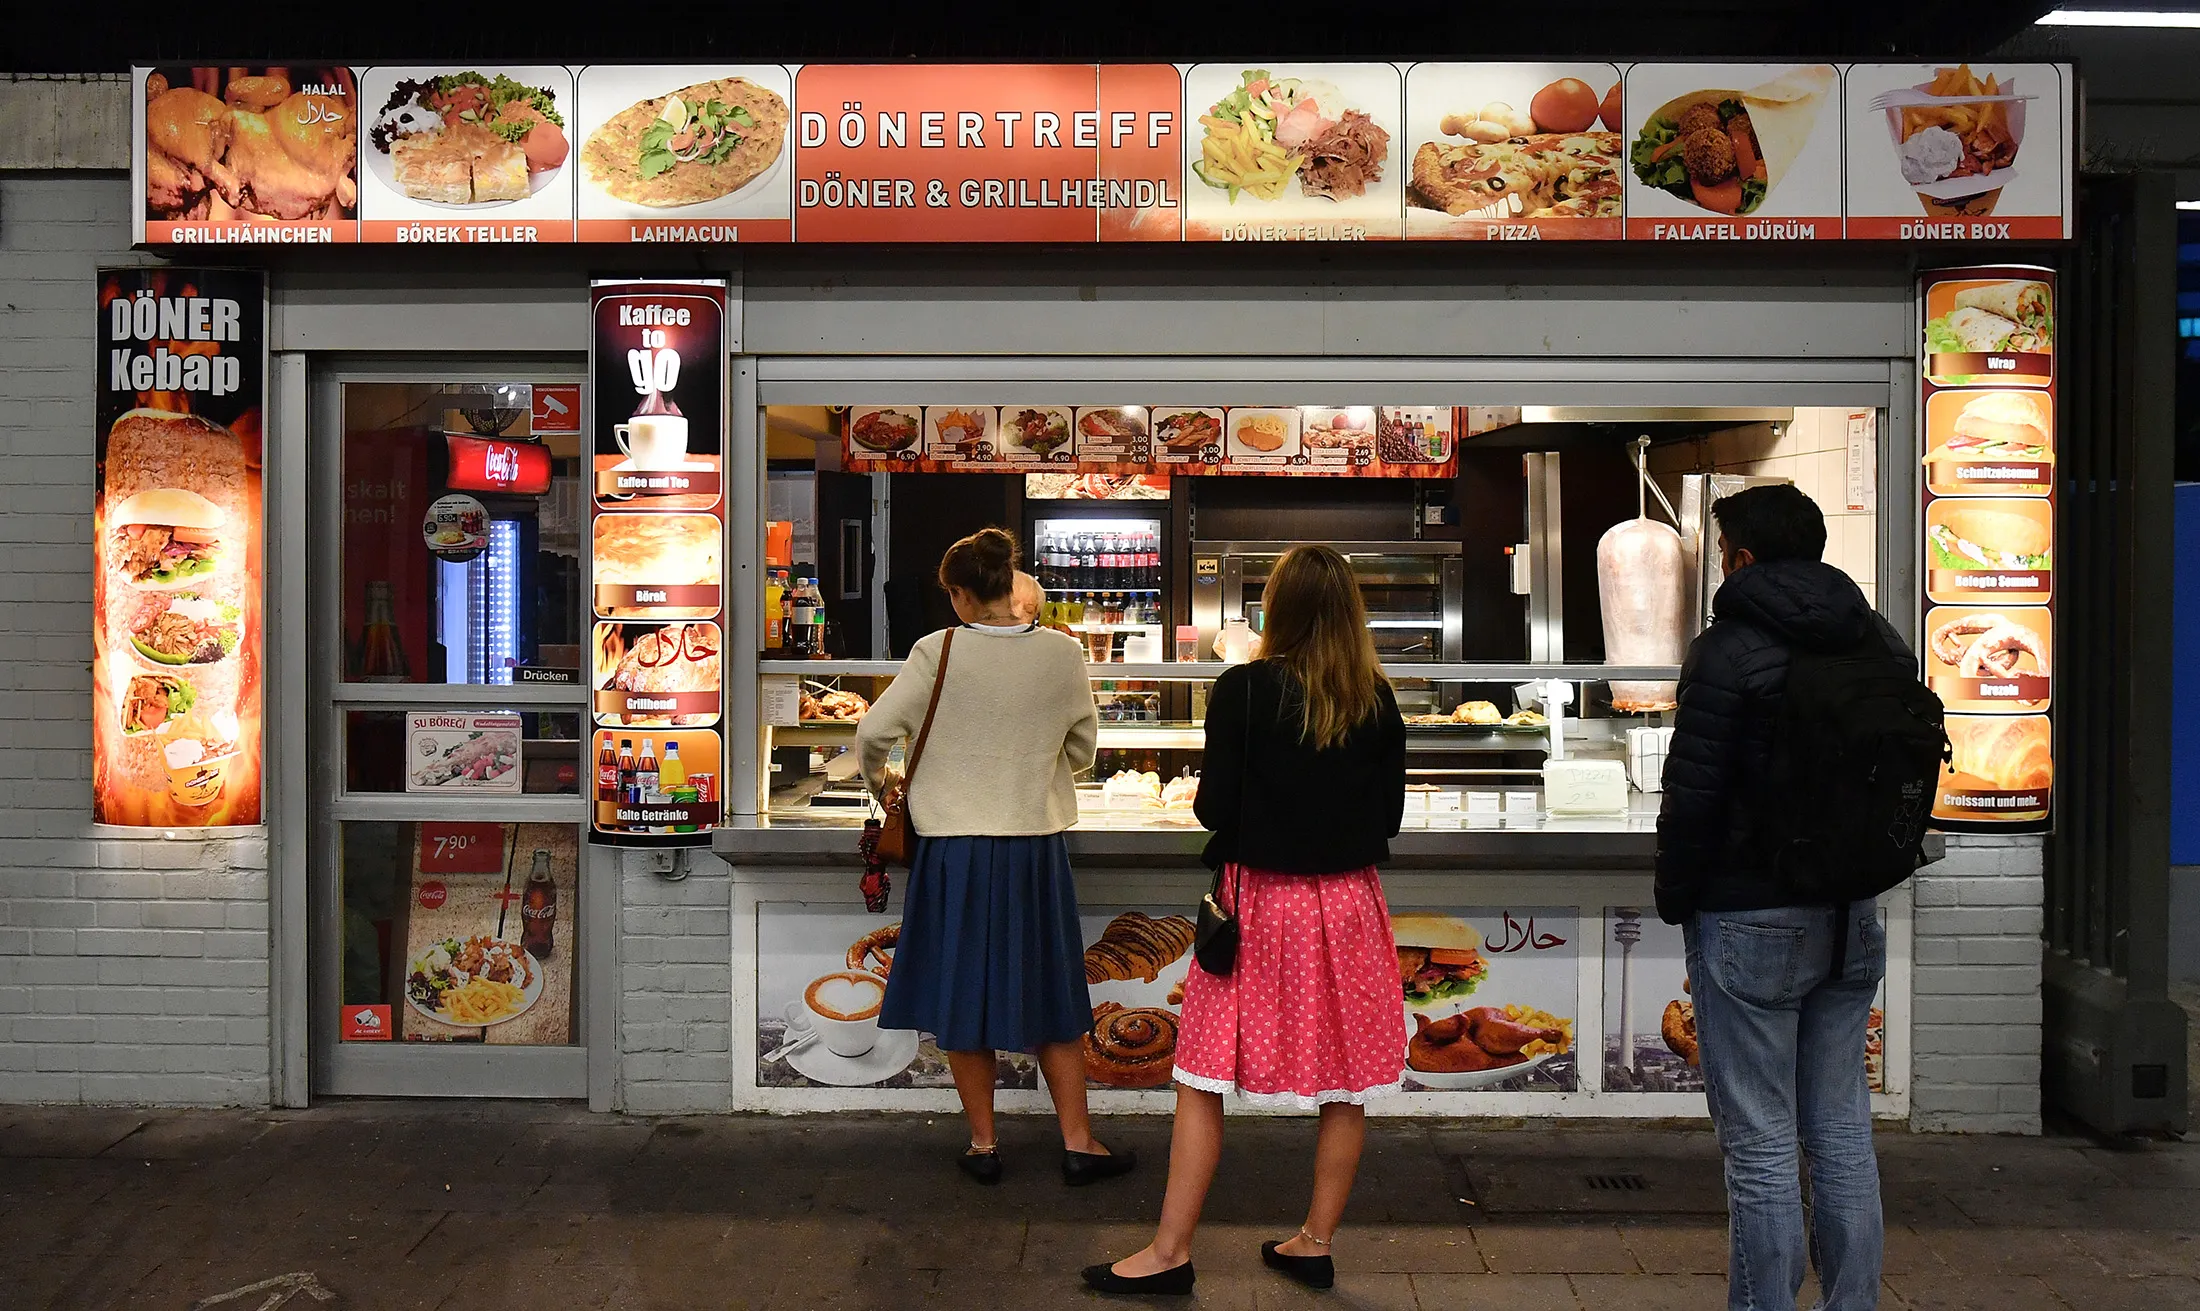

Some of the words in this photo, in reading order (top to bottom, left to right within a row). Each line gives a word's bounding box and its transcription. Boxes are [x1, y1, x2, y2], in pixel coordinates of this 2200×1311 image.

[302, 84, 346, 95] HALAL
[800, 101, 1173, 148] DÖNERTREFF
[800, 171, 916, 208] DÖNER
[926, 179, 950, 207] &
[959, 179, 1178, 208] GRILLHENDL
[171, 224, 332, 243] GRILLHÄHNCHEN
[396, 222, 465, 242] BÖREK
[465, 226, 538, 242] TELLER
[631, 226, 738, 242] LAHMACUN
[1221, 222, 1288, 241] DÖNER
[1292, 226, 1366, 241] TELLER
[1487, 225, 1542, 241] PIZZA
[1654, 224, 1741, 240] FALAFEL
[1746, 220, 1815, 240] DÜRÜM
[1900, 220, 1965, 240] DÖNER
[1971, 223, 2011, 240] BOX
[112, 290, 240, 341] DÖNER
[619, 304, 691, 326] Kaffee
[642, 328, 666, 348] to
[112, 348, 240, 396] Kebap
[627, 349, 681, 395] go
[1987, 357, 2016, 371] Wrap
[617, 476, 648, 489] Kaffee
[648, 476, 669, 489] und
[670, 476, 690, 489] Tee
[635, 590, 667, 603] Börek
[637, 627, 718, 668] حلال
[523, 670, 569, 681] Drücken
[1979, 683, 2019, 697] Brezeln
[626, 697, 678, 711] Grillhendl
[414, 719, 427, 729] SU
[1943, 793, 1996, 807] Croissant
[1997, 796, 2016, 808] und
[616, 809, 640, 821] Kalte
[641, 809, 689, 821] Getränke
[1484, 909, 1568, 953] حلال
